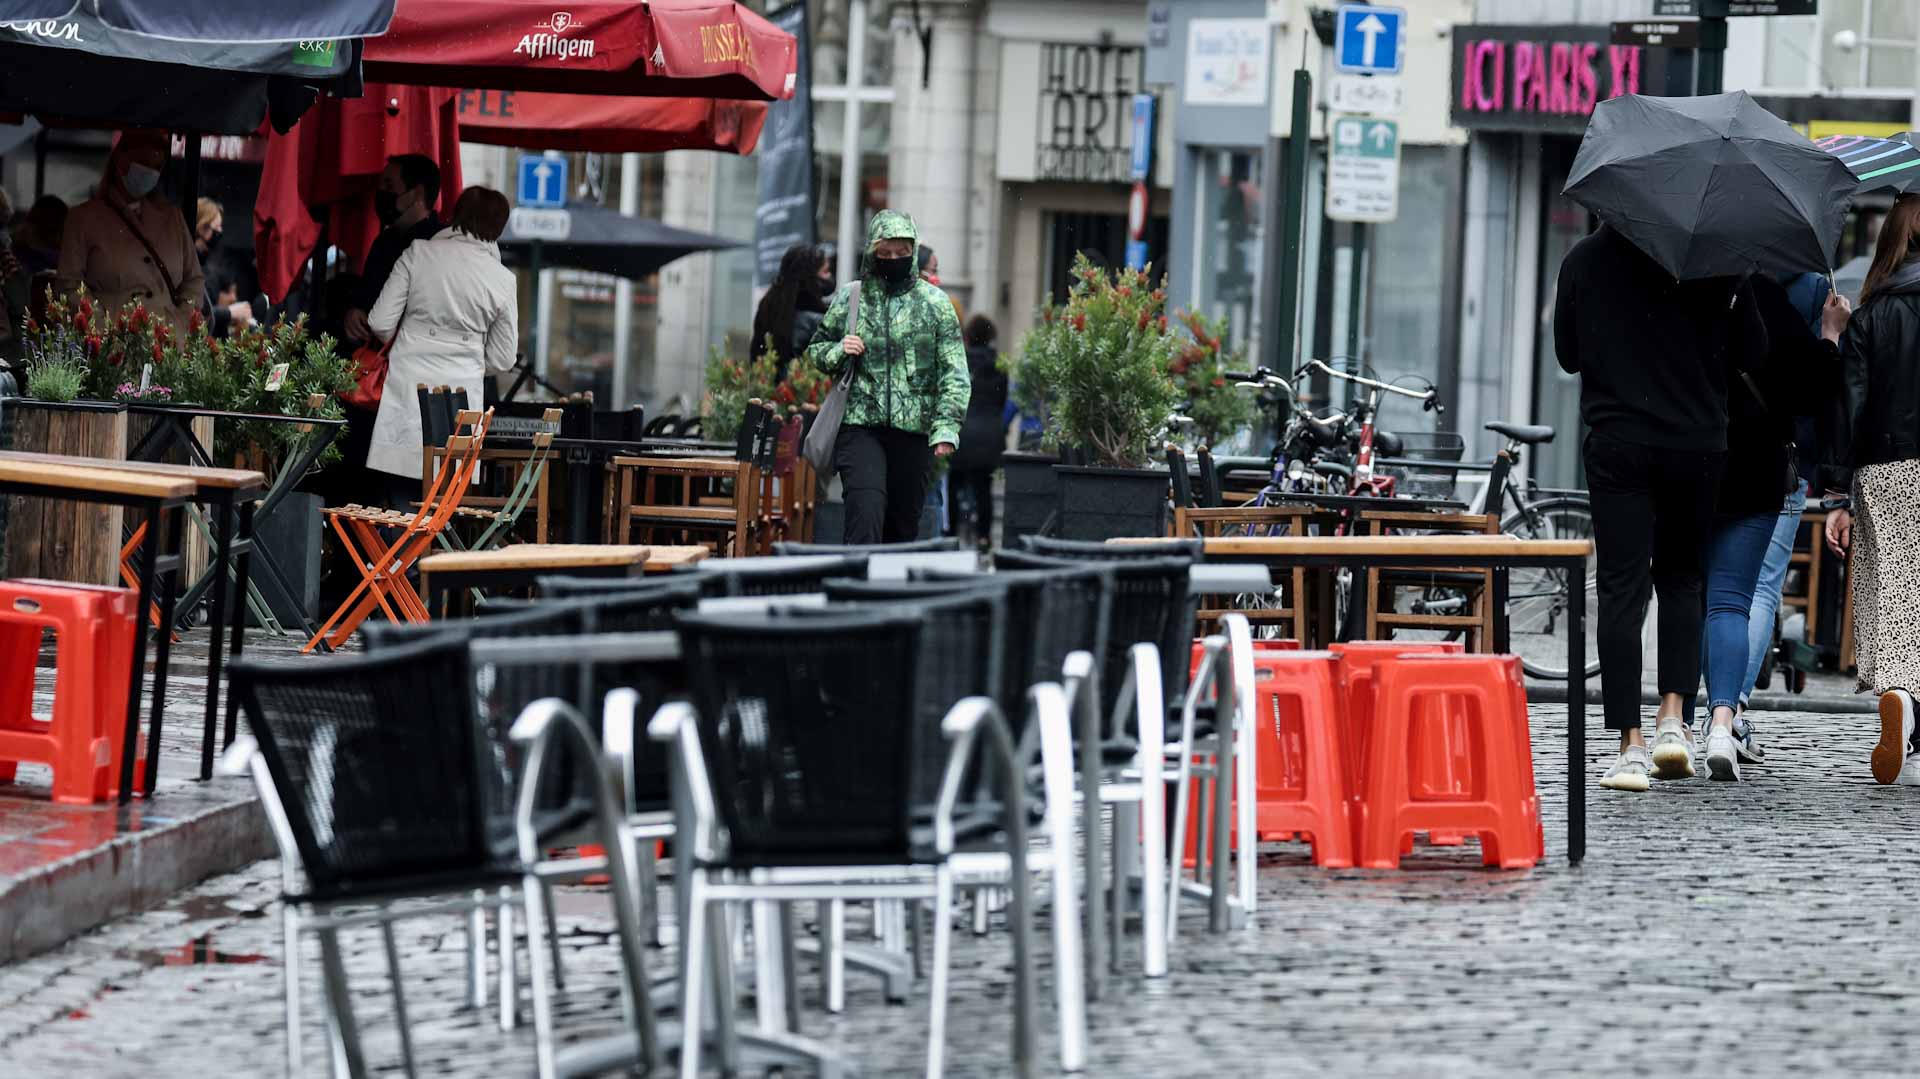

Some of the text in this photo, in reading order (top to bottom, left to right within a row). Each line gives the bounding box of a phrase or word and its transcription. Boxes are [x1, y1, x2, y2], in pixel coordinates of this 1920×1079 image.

[513, 33, 595, 61] Affligem
[1462, 39, 1505, 112] ICI
[1512, 41, 1599, 116] PARIS
